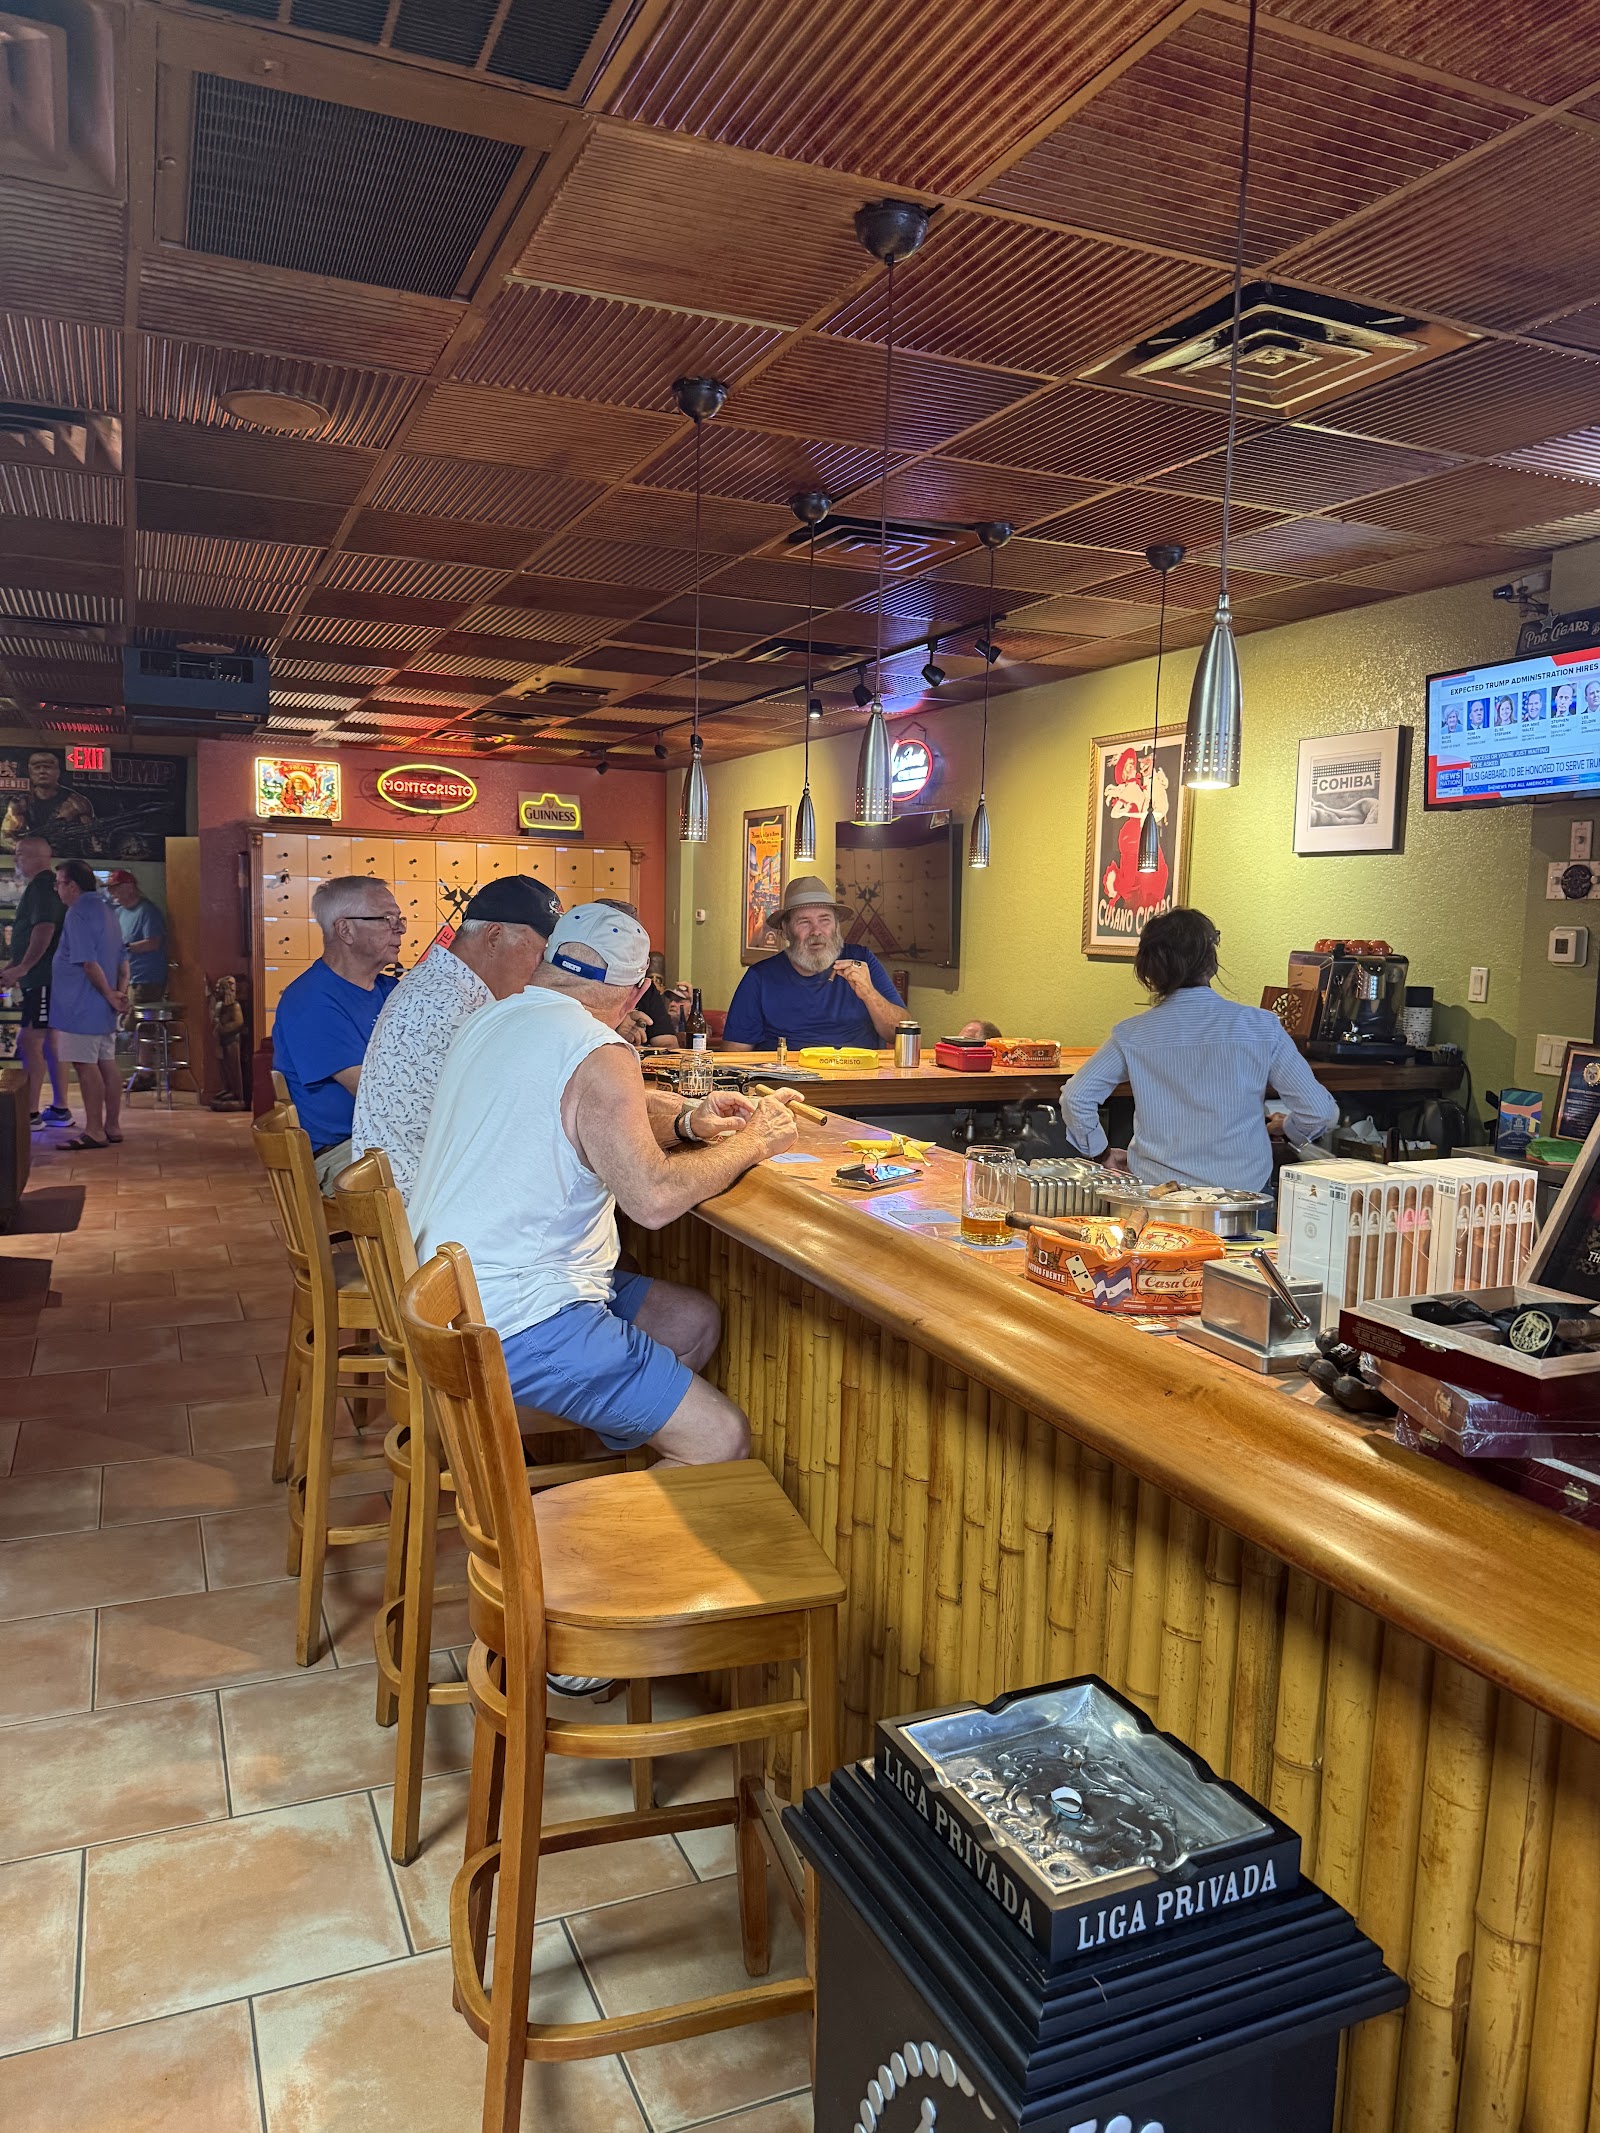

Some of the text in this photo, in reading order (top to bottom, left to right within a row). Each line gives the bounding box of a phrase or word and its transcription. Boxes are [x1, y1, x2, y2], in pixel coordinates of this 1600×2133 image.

[1526, 631, 1548, 648] PDR
[1551, 621, 1590, 641] CIGARS
[1450, 684, 1484, 696] EXPECTED
[1486, 680, 1510, 690] TRUMP
[1511, 668, 1574, 685] ADMINISTRATION
[1576, 663, 1598, 674] HIRES
[74, 747, 104, 769] EXIT
[1528, 747, 1548, 755] WAITING
[1465, 772, 1479, 781] TULSI
[1517, 767, 1524, 776] BE
[1525, 763, 1554, 775] HONORED
[1556, 762, 1564, 772] TO
[1566, 760, 1584, 771] SERVE
[382, 779, 473, 797] MONTECRISTO
[1319, 775, 1373, 791] COHIBA
[525, 807, 575, 822] GUINNESS
[1099, 899, 1133, 932] CUSANO
[1042, 1269, 1065, 1282] FUENTE
[1144, 1277, 1180, 1288] Casa
[883, 1746, 1036, 1939] LIGA PRIVADA
[1076, 1858, 1277, 1951] LIGA PRIVADA
